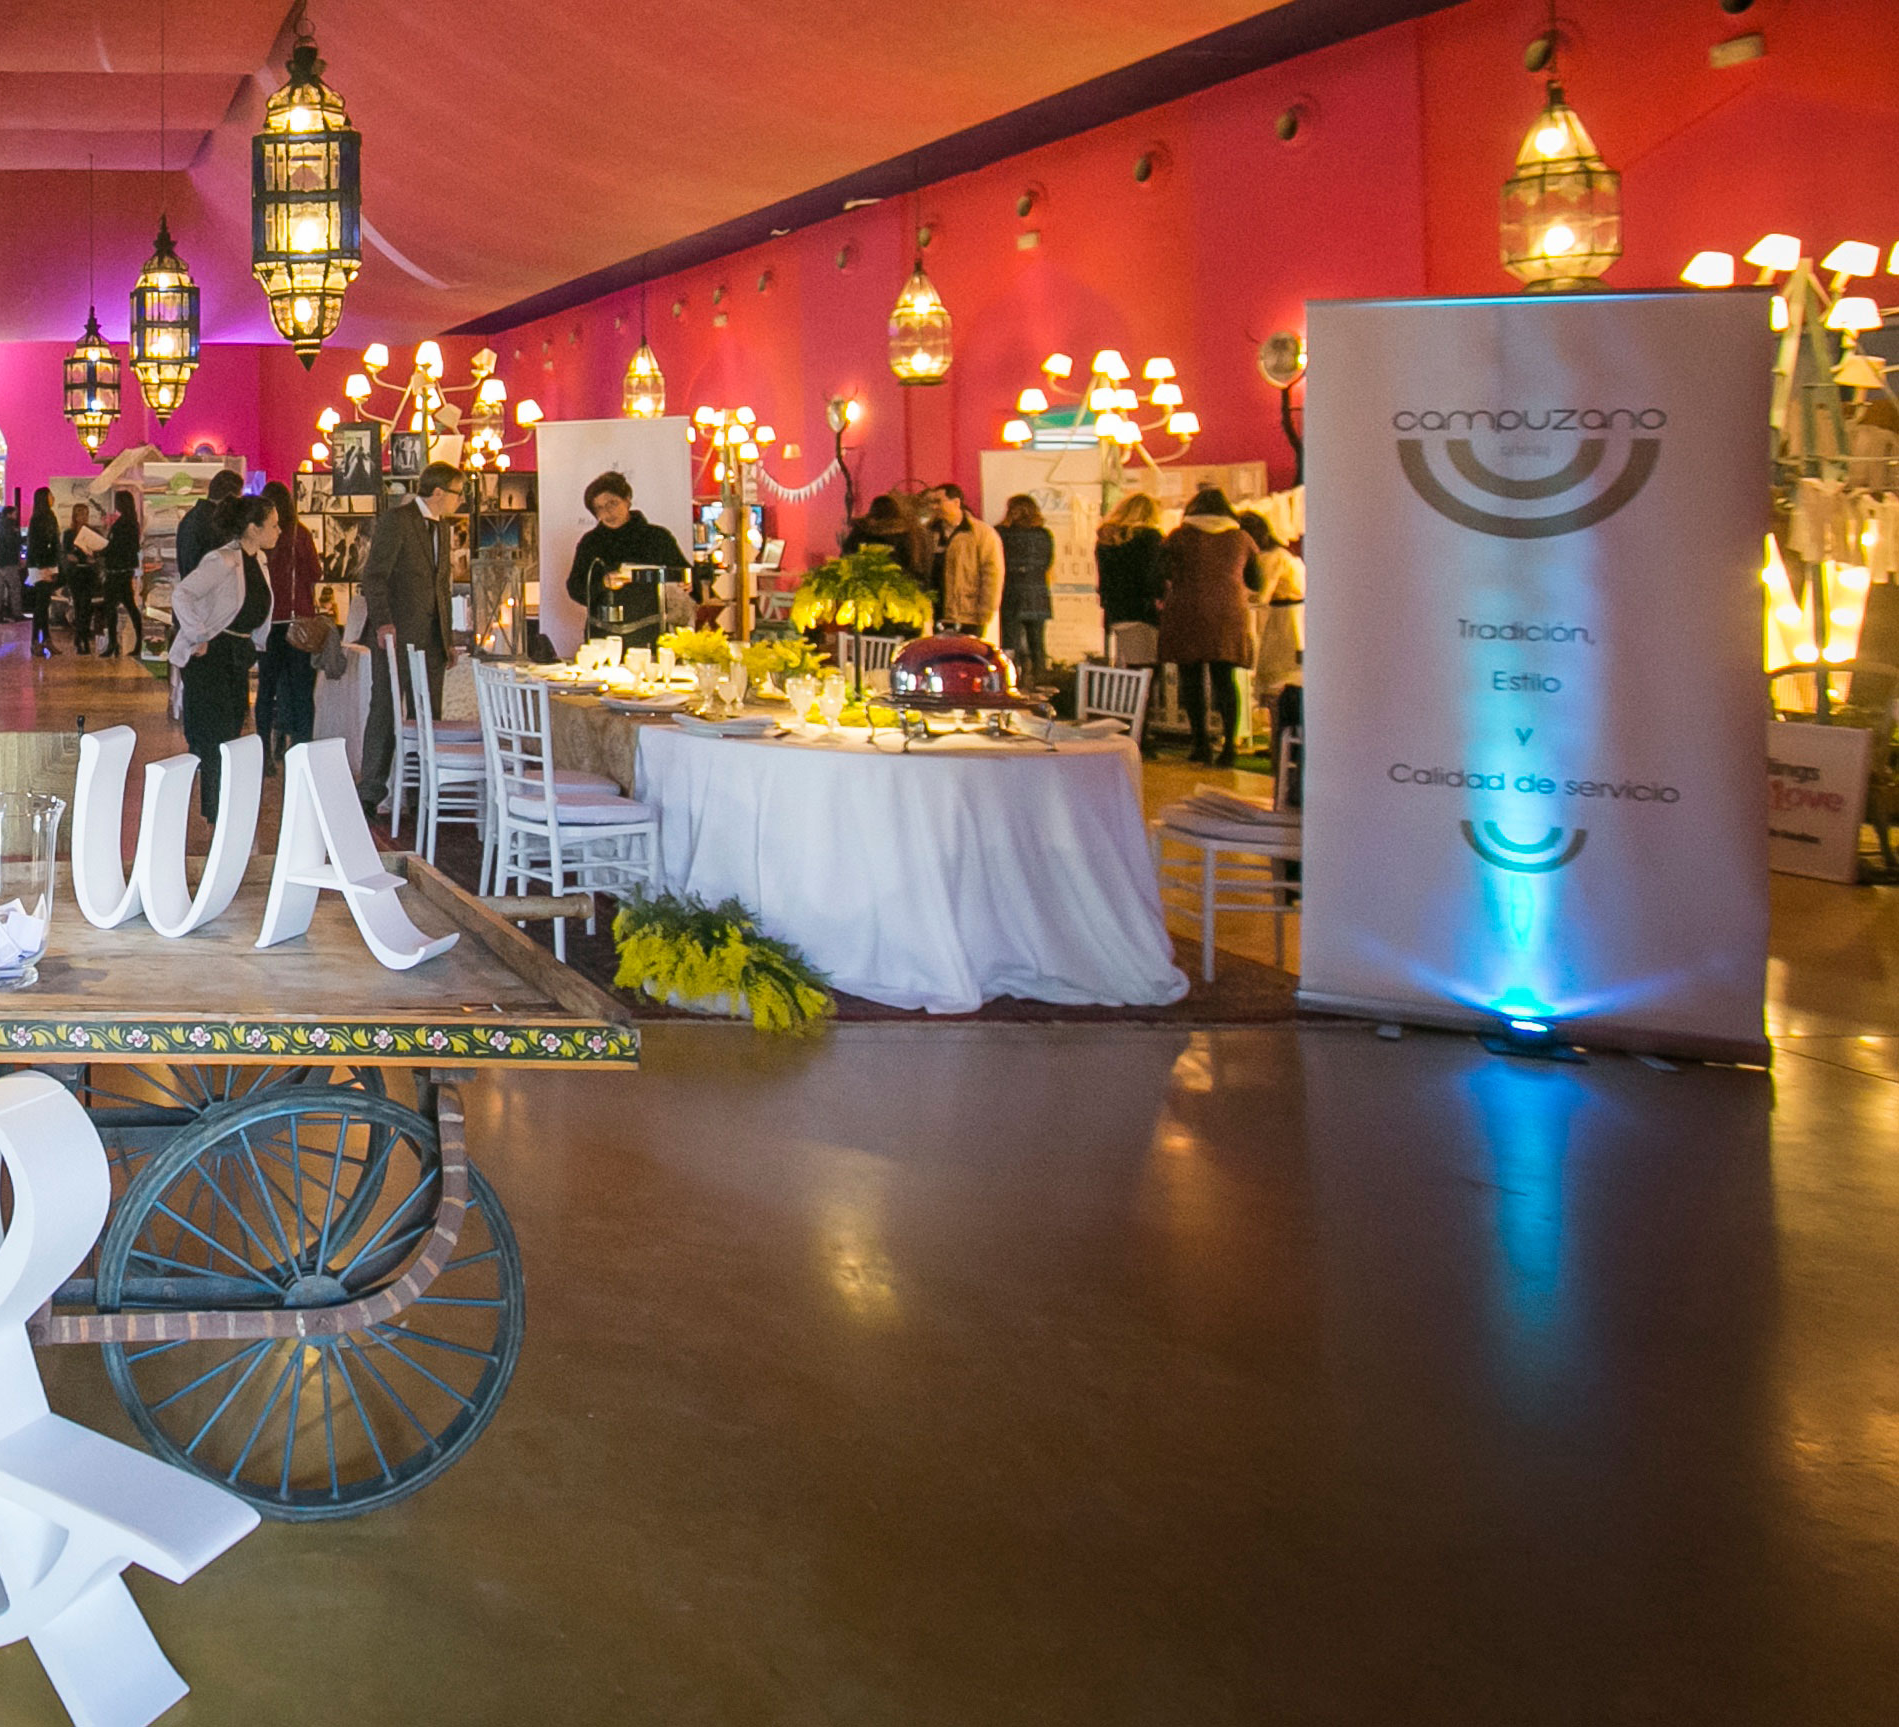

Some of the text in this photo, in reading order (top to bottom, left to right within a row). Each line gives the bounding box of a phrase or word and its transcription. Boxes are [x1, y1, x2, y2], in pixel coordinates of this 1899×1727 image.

[1392, 408, 1667, 433] campuzano
[1458, 618, 1596, 646] Tradición,
[1492, 671, 1562, 694] Estilo
[1387, 763, 1681, 804] Calidad de servicio
